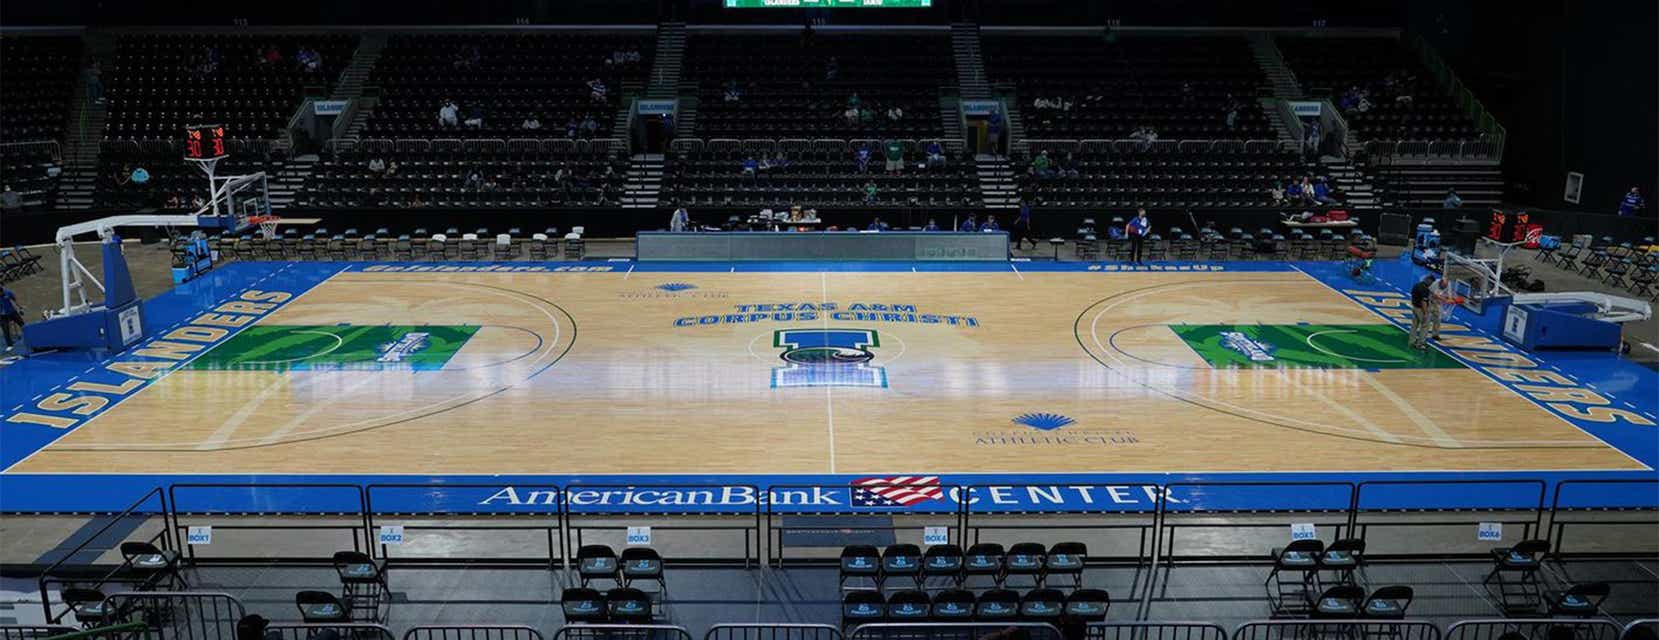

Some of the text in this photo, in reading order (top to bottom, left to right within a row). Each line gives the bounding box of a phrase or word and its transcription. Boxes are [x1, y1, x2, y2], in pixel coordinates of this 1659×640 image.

[186, 139, 202, 157] 30
[211, 138, 225, 156] 30
[734, 302, 918, 313] TEXAS A&M
[673, 311, 980, 328] CORPUS CHRISTI
[8, 289, 293, 429] ISLANDERS
[975, 436, 1140, 445] ATHLETIC CLUB
[949, 485, 1180, 505] CENTER
